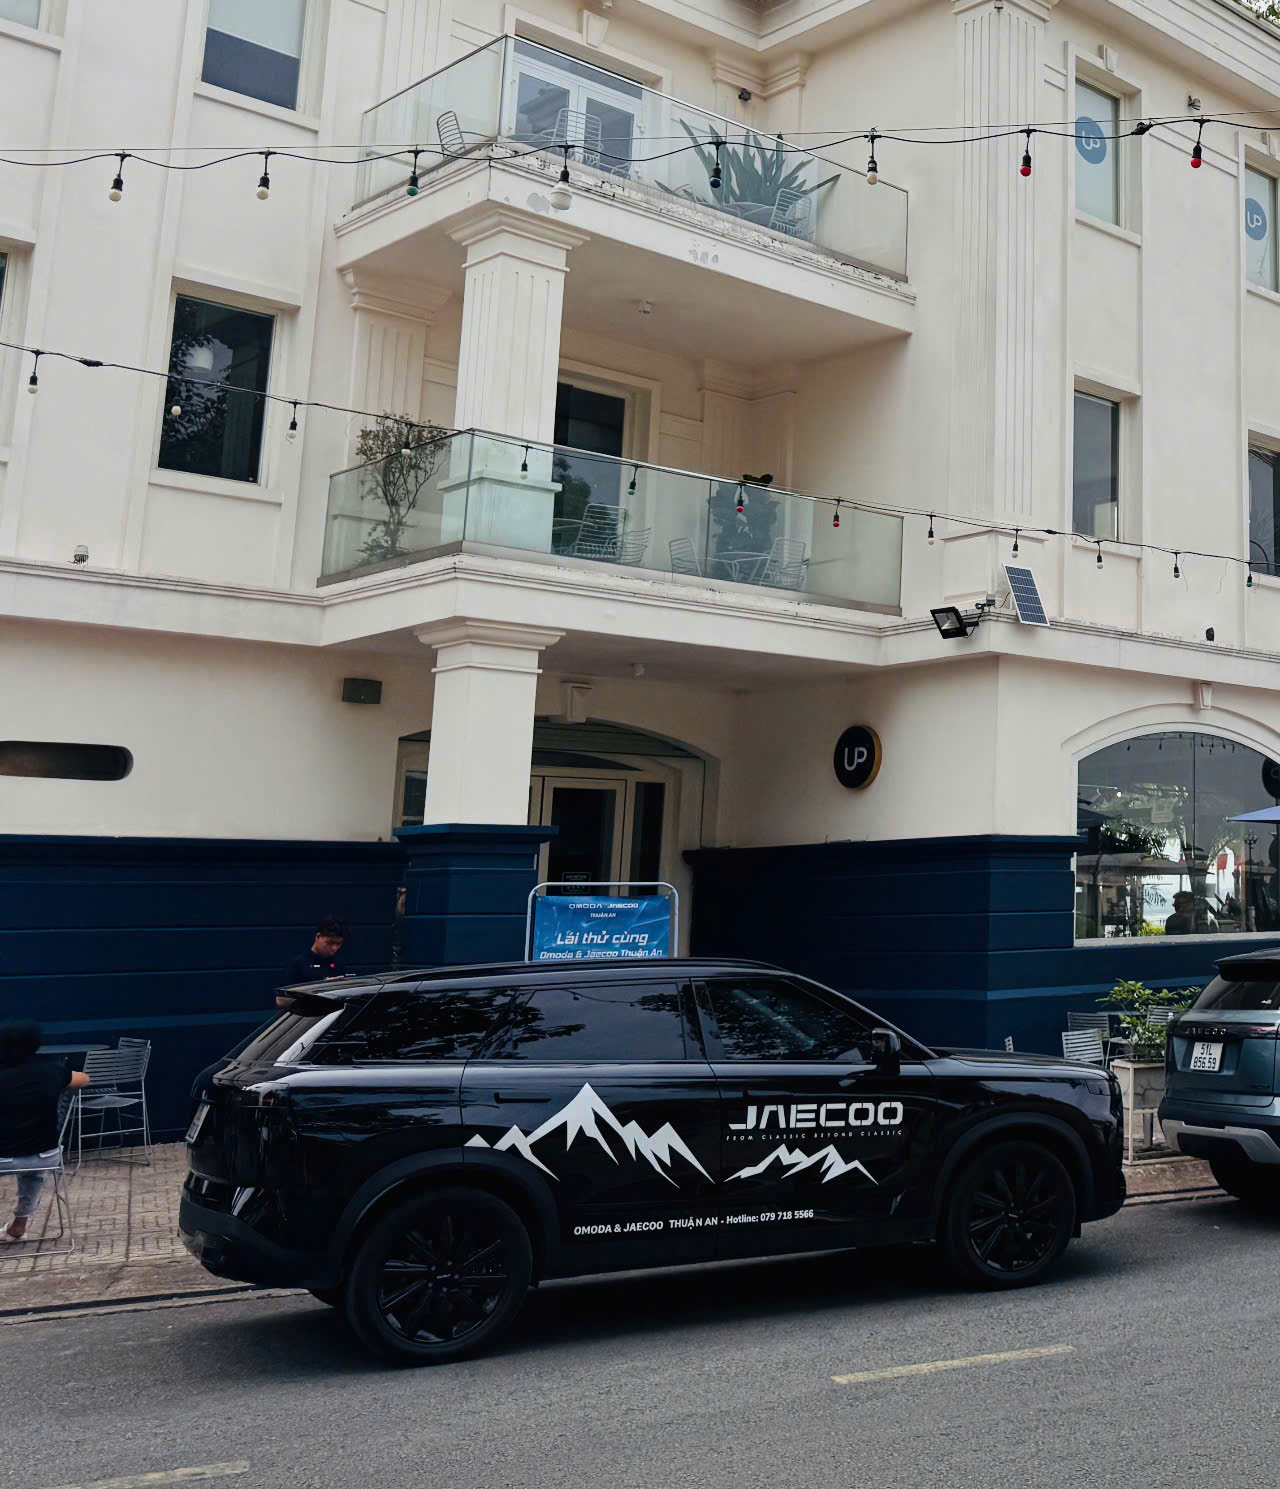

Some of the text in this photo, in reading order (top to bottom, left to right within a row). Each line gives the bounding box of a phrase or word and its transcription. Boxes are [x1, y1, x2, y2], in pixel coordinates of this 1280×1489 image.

[1247, 210, 1263, 228] UP
[844, 746, 868, 771] UP
[556, 930, 649, 946] Lái thử cùng
[539, 948, 663, 959] Omoda & Jaecoo Thuận An
[1200, 1043, 1213, 1056] 51L
[728, 1101, 904, 1130] JAECOO
[573, 1224, 612, 1235] OMODA
[614, 1223, 622, 1232] &
[623, 1220, 664, 1232] JAECOO
[704, 1216, 718, 1226] AN
[726, 1213, 759, 1224] Hotline:
[760, 1212, 776, 1222] 079
[777, 1210, 793, 1220] 718
[794, 1209, 814, 1219] 5566
